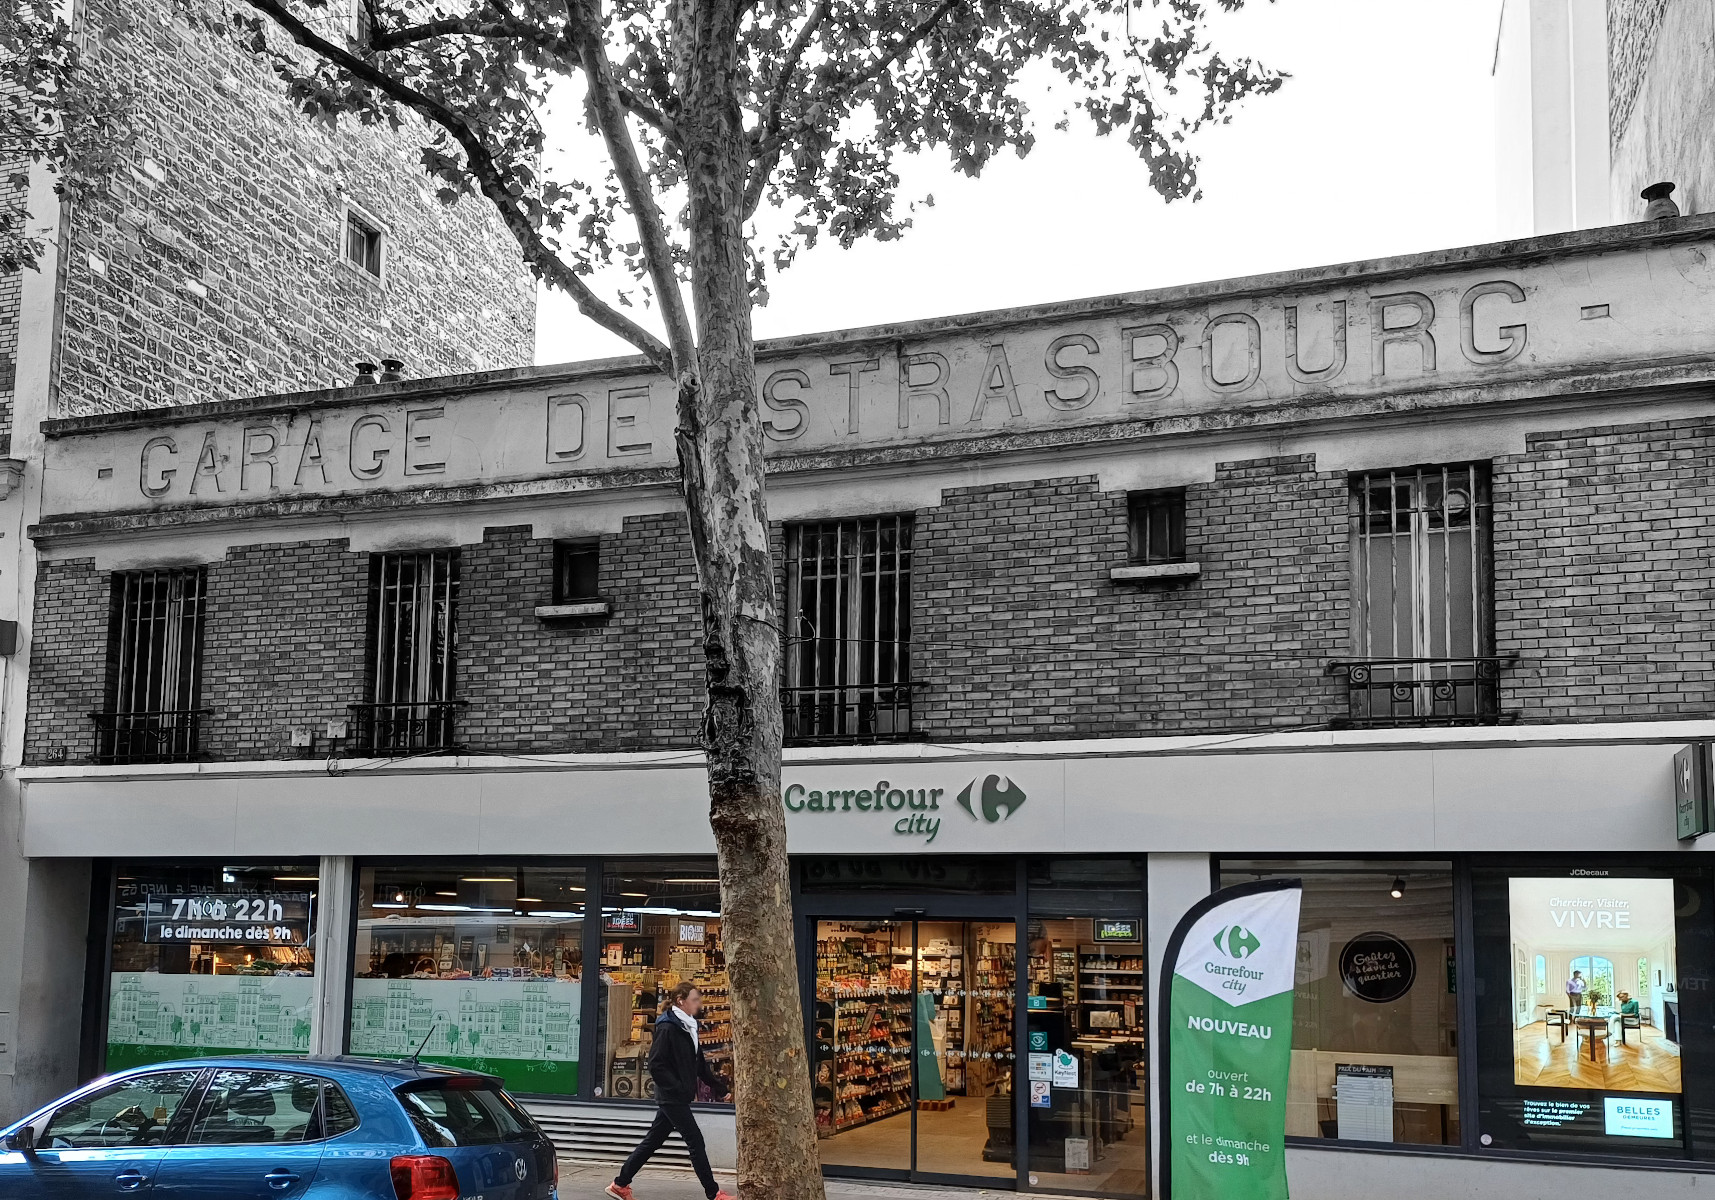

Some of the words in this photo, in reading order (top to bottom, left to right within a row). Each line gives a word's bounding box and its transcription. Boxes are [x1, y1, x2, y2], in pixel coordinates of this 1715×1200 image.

[140, 407, 446, 498] GARAGE
[547, 385, 653, 465] DE
[762, 280, 1527, 441] STRASBOURG
[48, 748, 64, 759] 264
[784, 780, 944, 812] Carrefour
[893, 813, 941, 843] city
[235, 899, 283, 921] 22h
[1549, 896, 1594, 908] Chercher,
[1596, 898, 1630, 909] Visiter,
[1550, 910, 1631, 928] VIVRE
[160, 925, 173, 938] le
[175, 926, 244, 939] dimanche
[246, 925, 270, 939] dès
[274, 927, 291, 940] 9h
[1205, 962, 1264, 980] Carrefour
[1358, 971, 1401, 984] quartier
[1222, 979, 1247, 995] city
[1187, 1015, 1272, 1039] NOUVEAU
[1208, 1070, 1248, 1082] ouvert
[1185, 1080, 1205, 1093] de
[1209, 1082, 1224, 1096] 7h
[1229, 1085, 1238, 1097] à
[1243, 1087, 1272, 1101] 22h
[1616, 1106, 1661, 1115] BELLES
[1186, 1133, 1198, 1144] et
[1201, 1134, 1213, 1145] le
[1216, 1137, 1270, 1152] dimanche
[1208, 1151, 1233, 1164] dès
[1236, 1153, 1249, 1166] 9h
